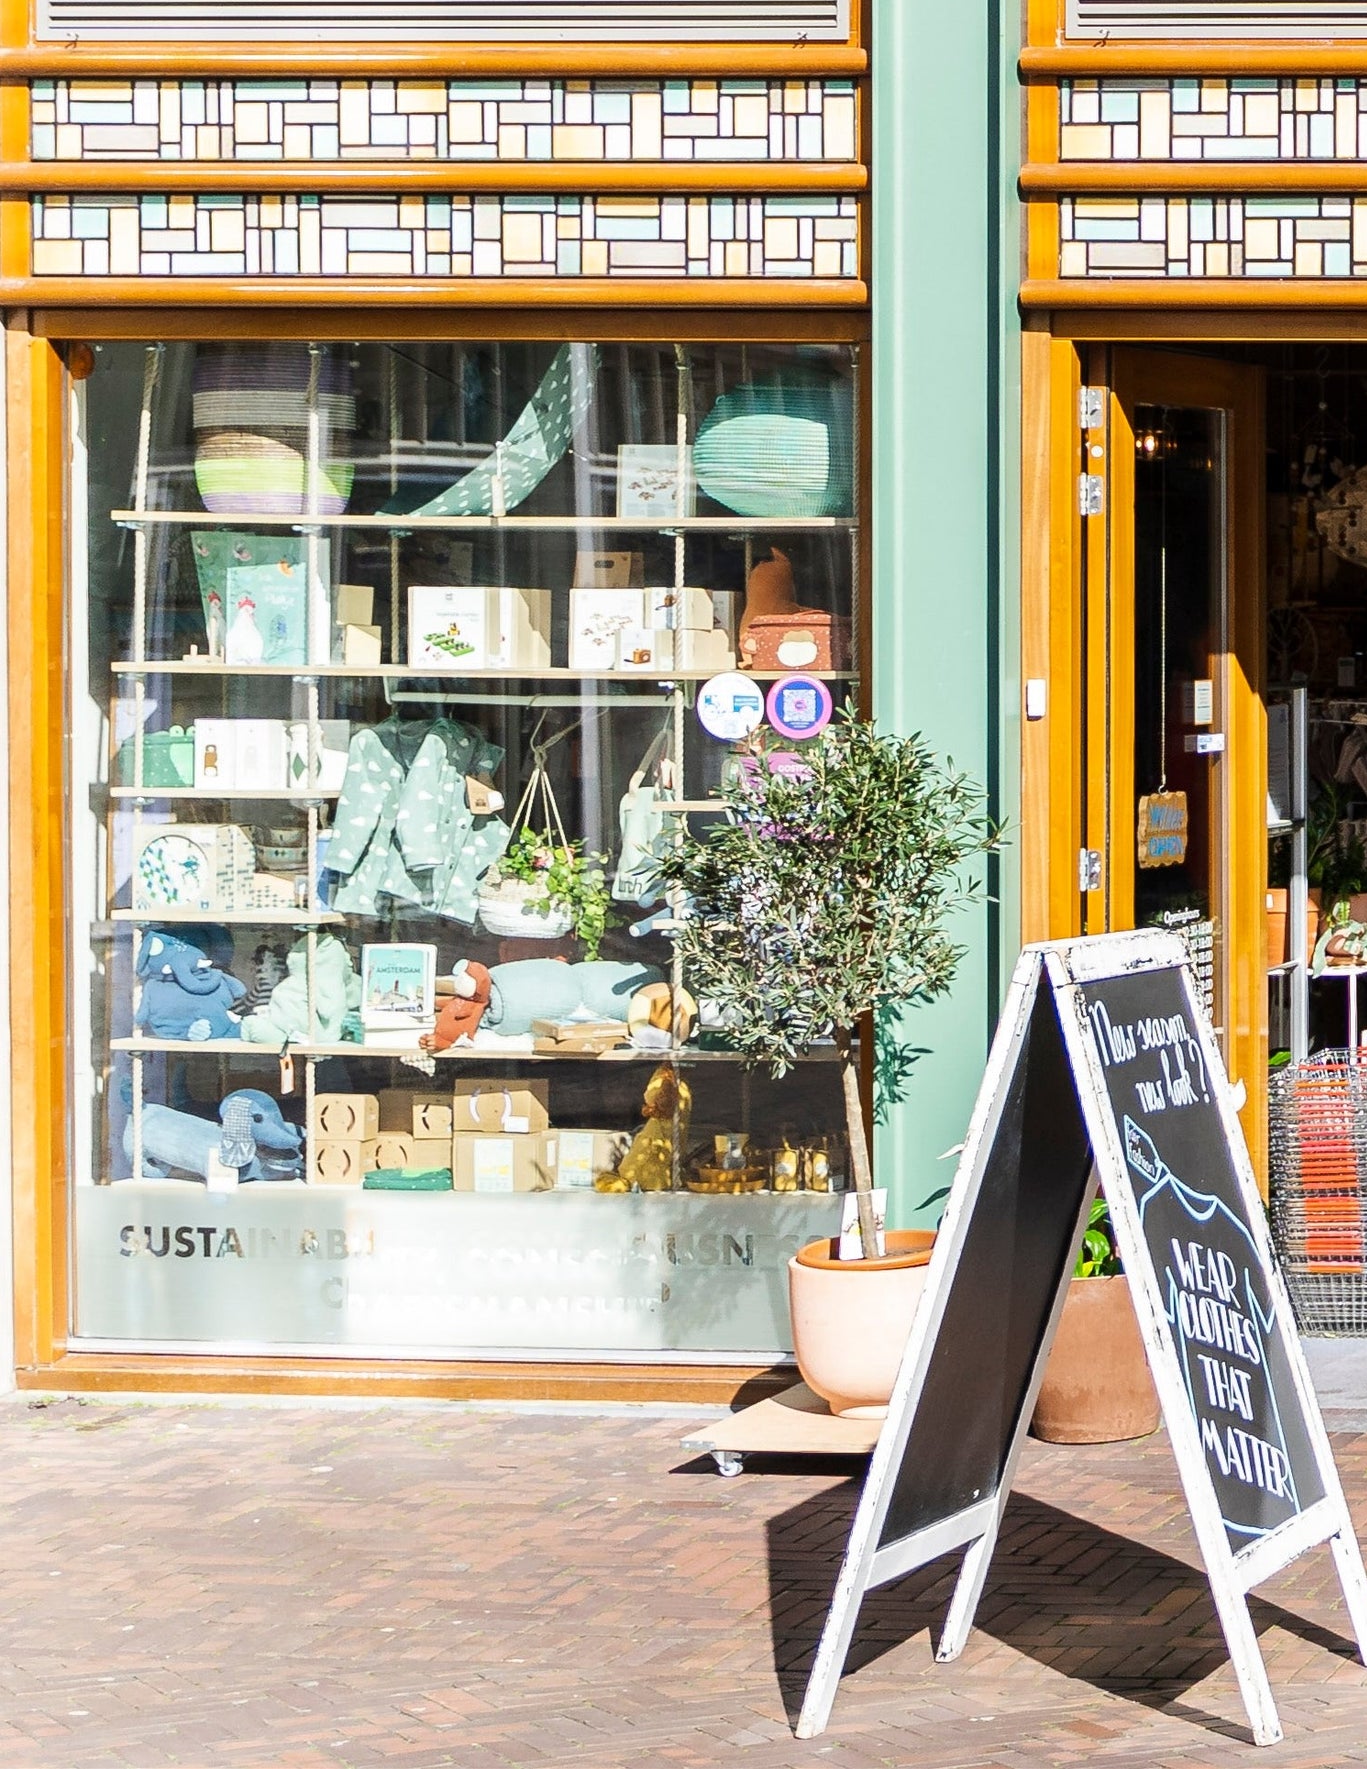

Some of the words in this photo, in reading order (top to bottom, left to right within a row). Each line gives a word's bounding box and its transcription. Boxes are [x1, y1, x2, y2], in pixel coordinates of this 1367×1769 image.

[1089, 1000, 1137, 1066] New
[1135, 1080, 1166, 1113] new
[1171, 1237, 1241, 1309] WEAR
[1179, 1290, 1260, 1365] CLOTHES
[1197, 1353, 1254, 1421] THAT
[1201, 1418, 1294, 1502] MATTER
